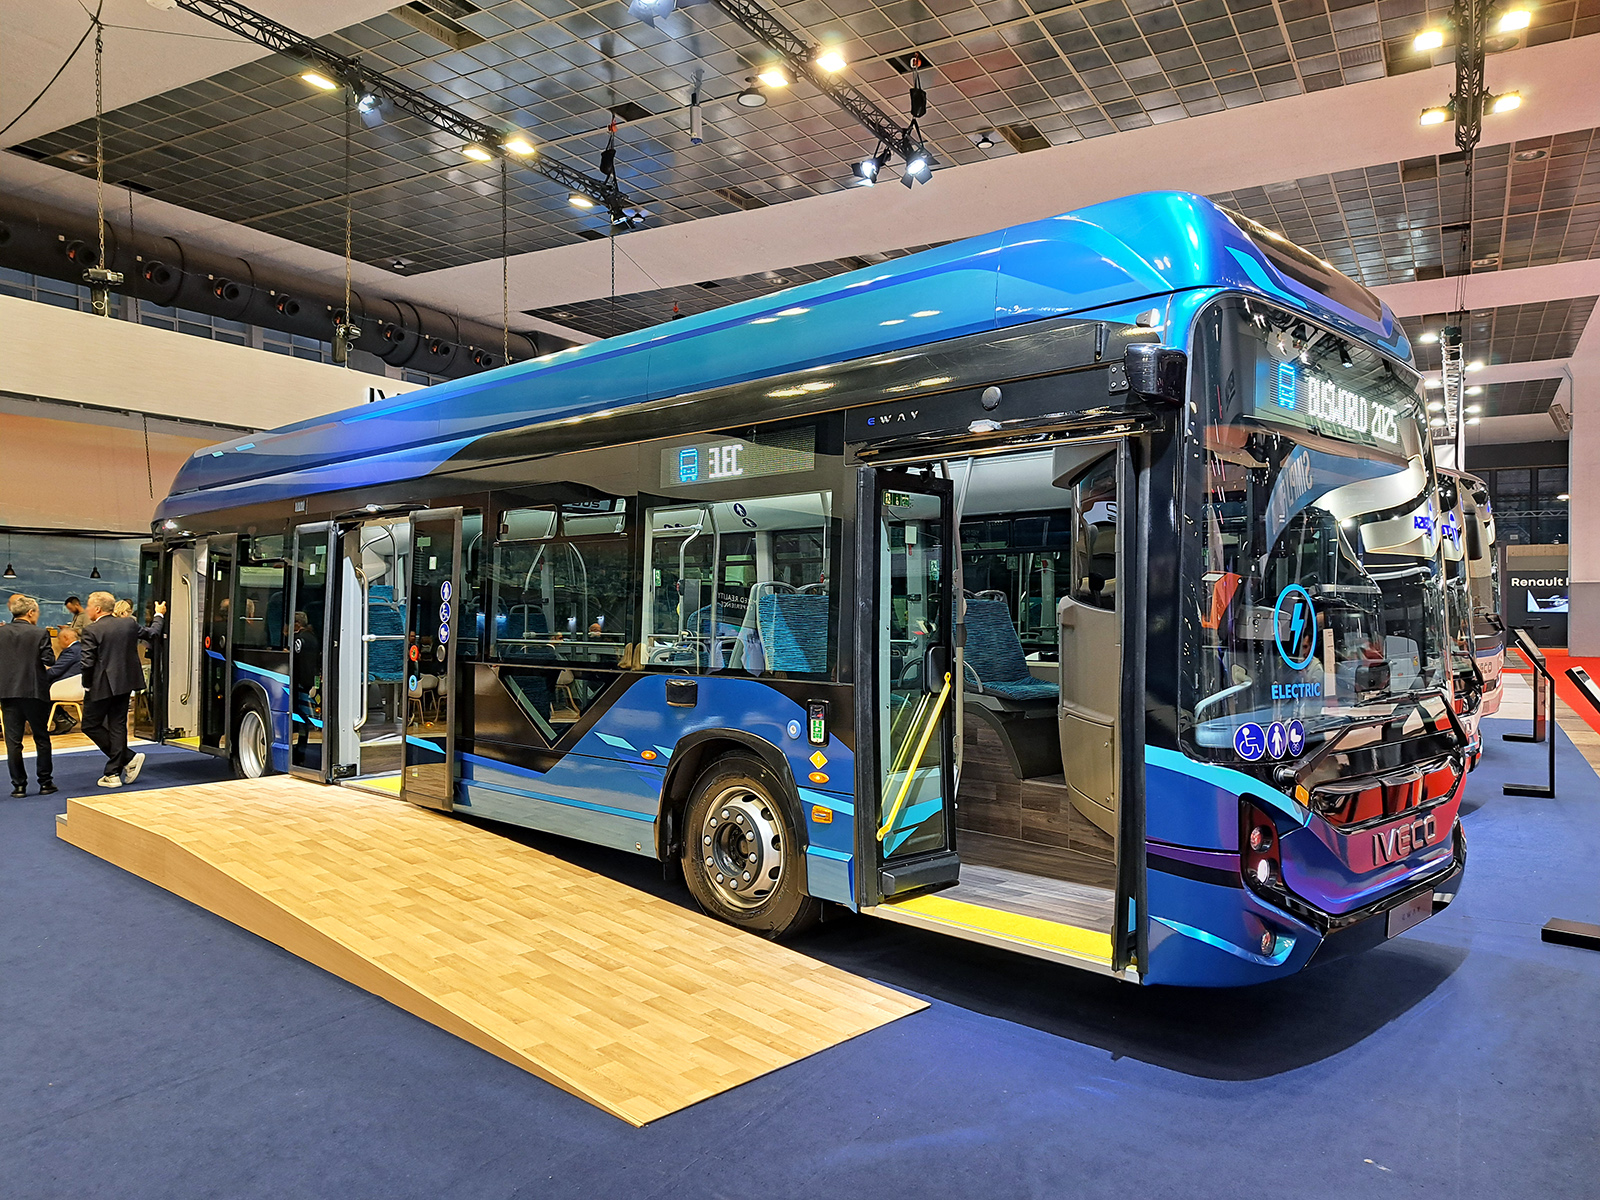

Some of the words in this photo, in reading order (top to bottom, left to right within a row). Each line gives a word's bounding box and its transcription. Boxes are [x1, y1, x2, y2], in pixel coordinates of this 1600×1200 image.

[1307, 376, 1368, 434] BUSWORLD
[1371, 401, 1398, 444] 2025
[1511, 577, 1563, 587] Renault
[1271, 683, 1321, 700] ELECTRIC
[1372, 814, 1437, 867] IVECO
